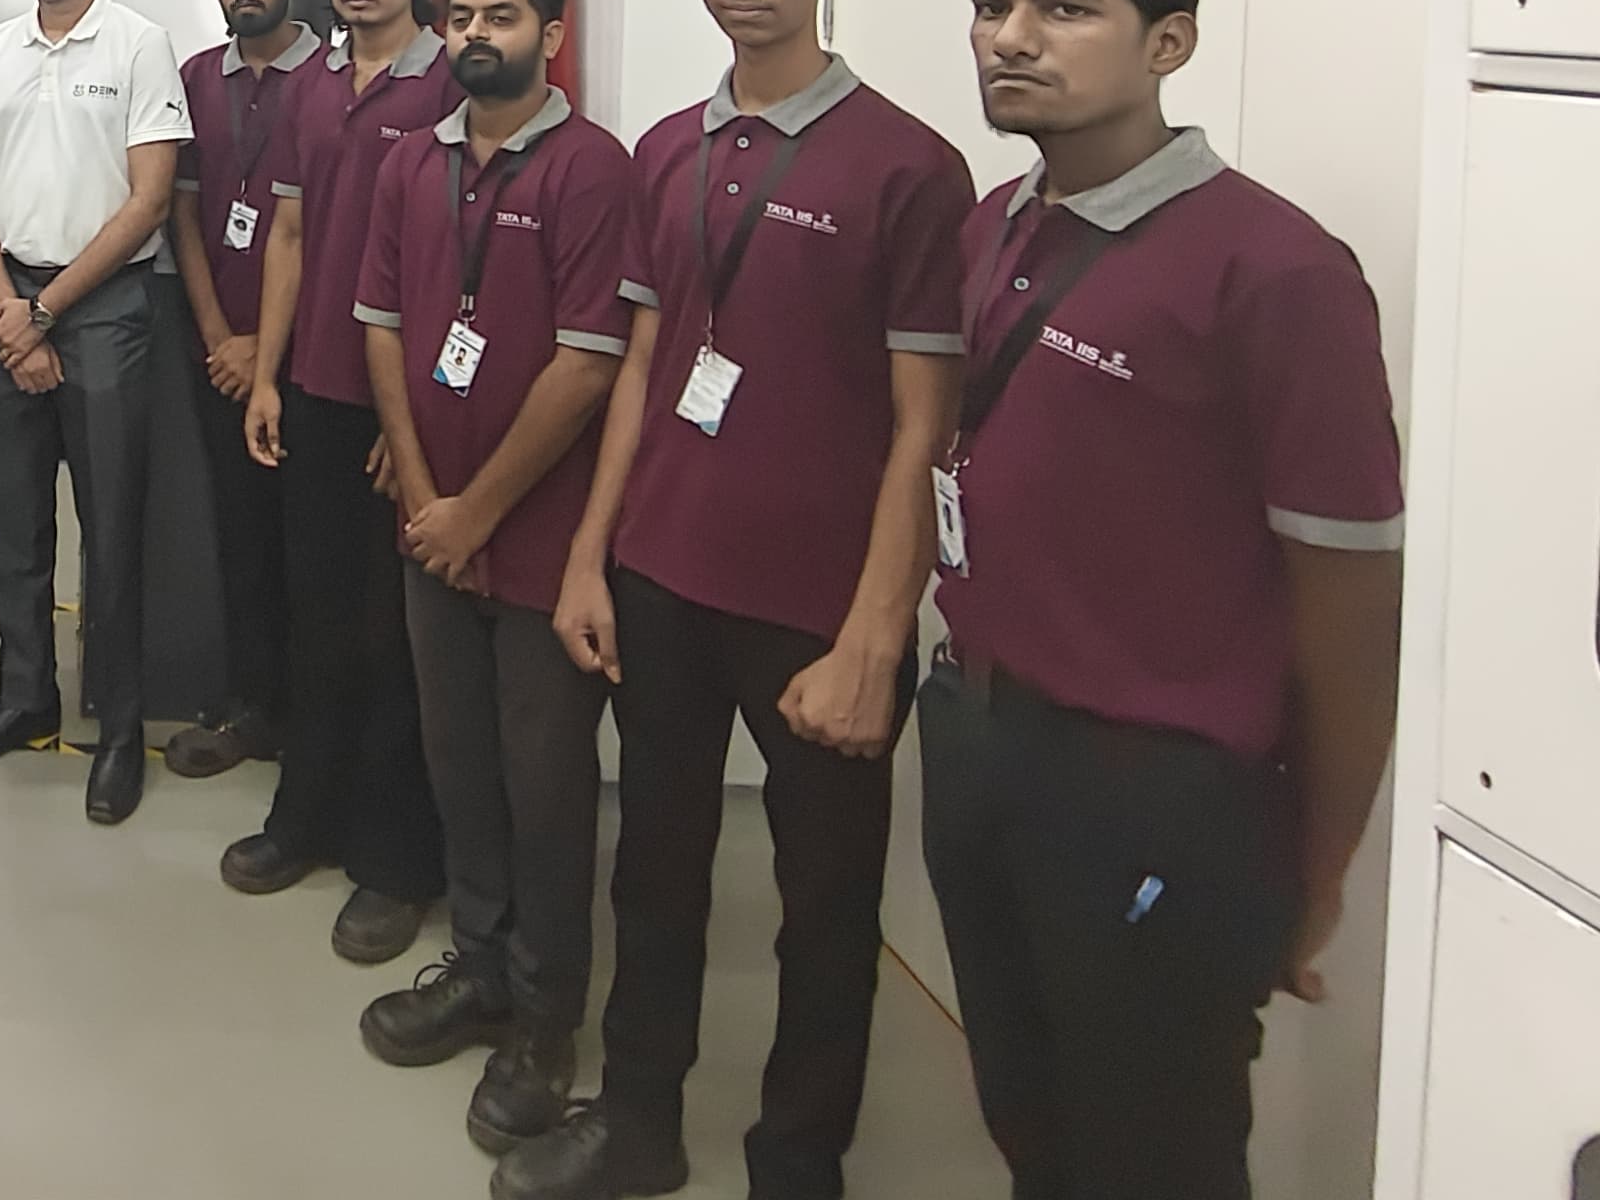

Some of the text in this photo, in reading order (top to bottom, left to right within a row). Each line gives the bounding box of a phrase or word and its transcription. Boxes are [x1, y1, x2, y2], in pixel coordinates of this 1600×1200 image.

[88, 85, 119, 96] DEIN
[380, 126, 402, 137] TATA
[496, 212, 520, 223] TATA
[765, 202, 794, 218] TATA
[796, 210, 814, 224] IIS
[1041, 325, 1074, 350] TATA
[1075, 341, 1101, 361] IIS
